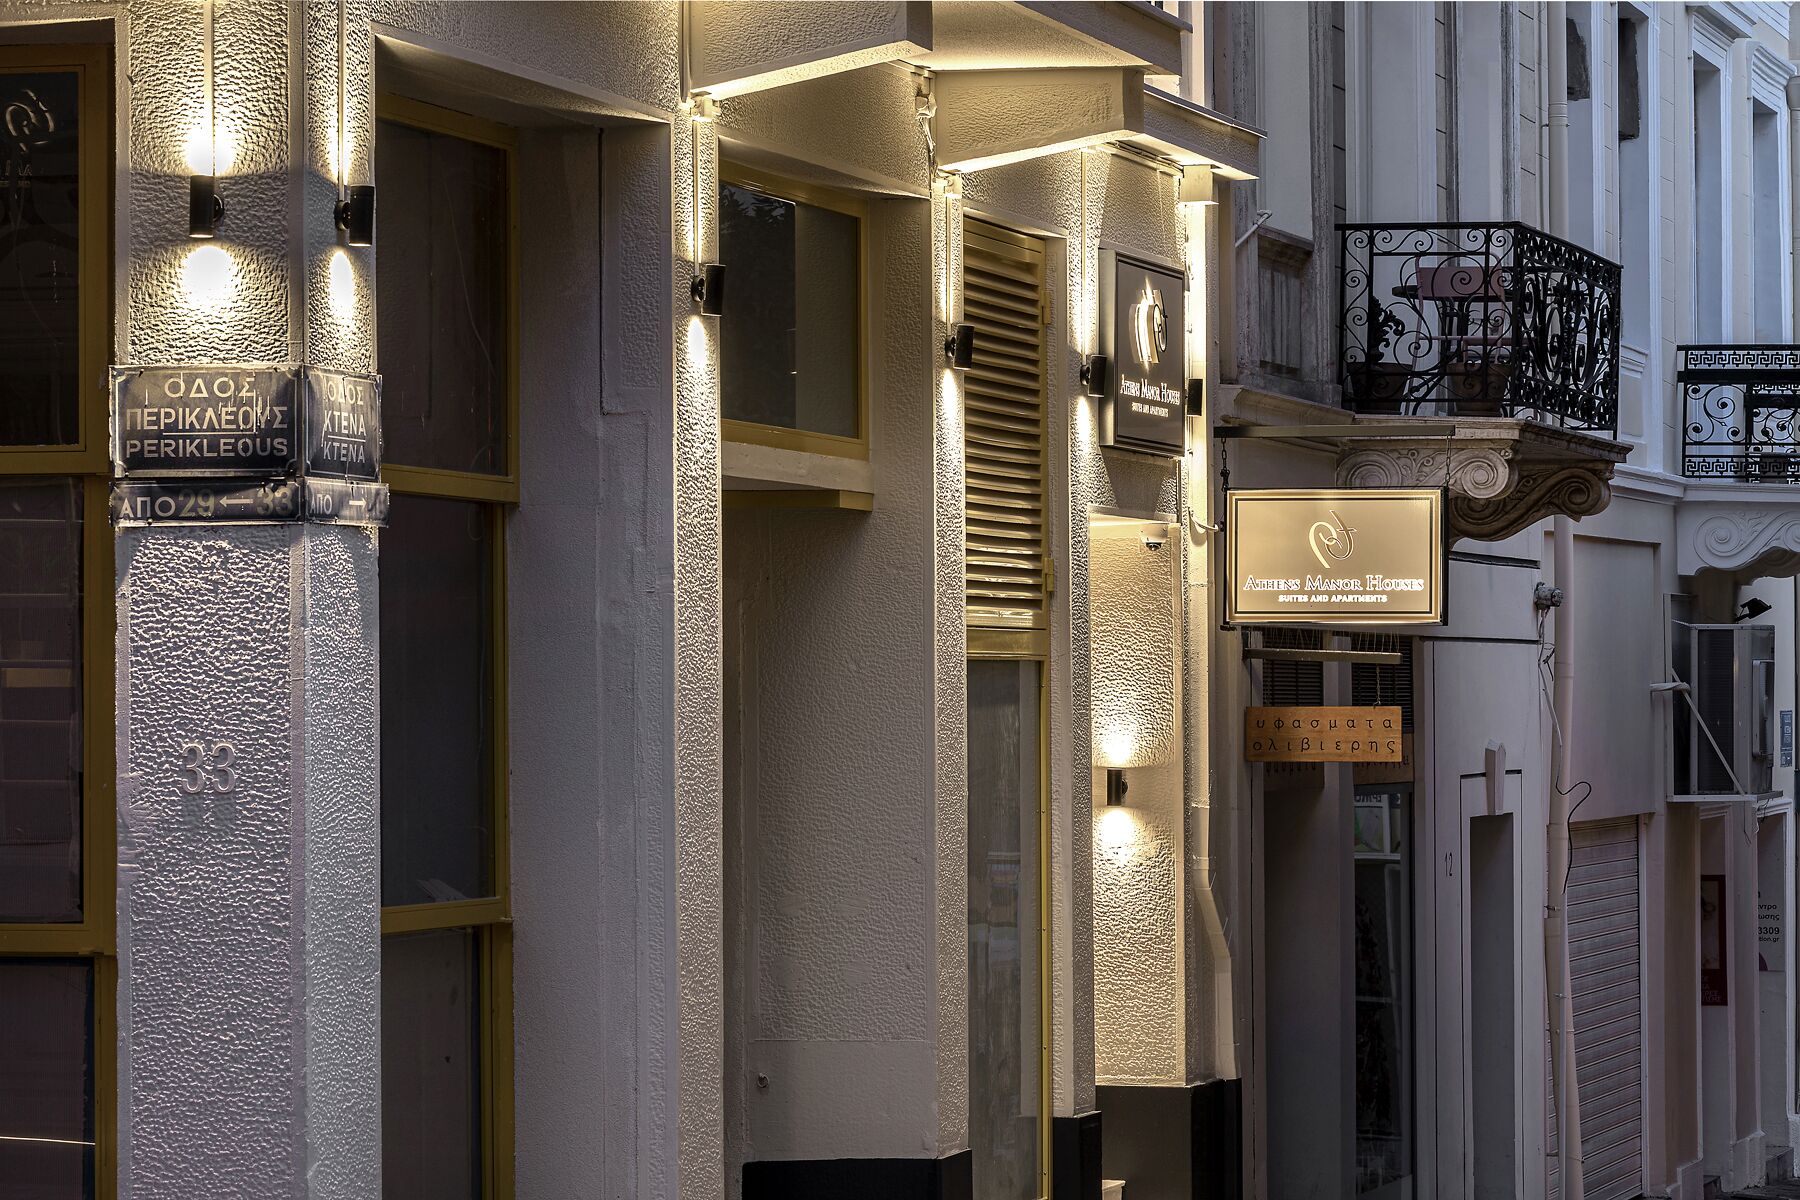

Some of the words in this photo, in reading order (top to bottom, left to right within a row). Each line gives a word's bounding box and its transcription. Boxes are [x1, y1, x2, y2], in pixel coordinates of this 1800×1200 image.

[164, 377, 255, 398] ΟΔΟΣ
[327, 381, 364, 405] ΟΔΟΣ
[126, 406, 288, 430] ΠΕΡΙΚΛΕΟΥΣ
[324, 410, 367, 436] ΚΤΕΝΑ
[126, 438, 288, 458] PERIKLEOUS
[323, 441, 366, 463] KTENA
[119, 496, 176, 518] ΑΠΟ
[178, 489, 215, 517] 29
[256, 487, 293, 516] 33
[310, 493, 333, 515] ΑΠΟ
[1278, 594, 1309, 603] SUITES
[1310, 594, 1329, 603] AND
[1330, 594, 1388, 603] APARTMENTS
[1256, 718, 1393, 731] υφασματα
[1252, 737, 1396, 754] ολιβιερης
[182, 743, 236, 794] 33
[1444, 852, 1453, 877] 12
